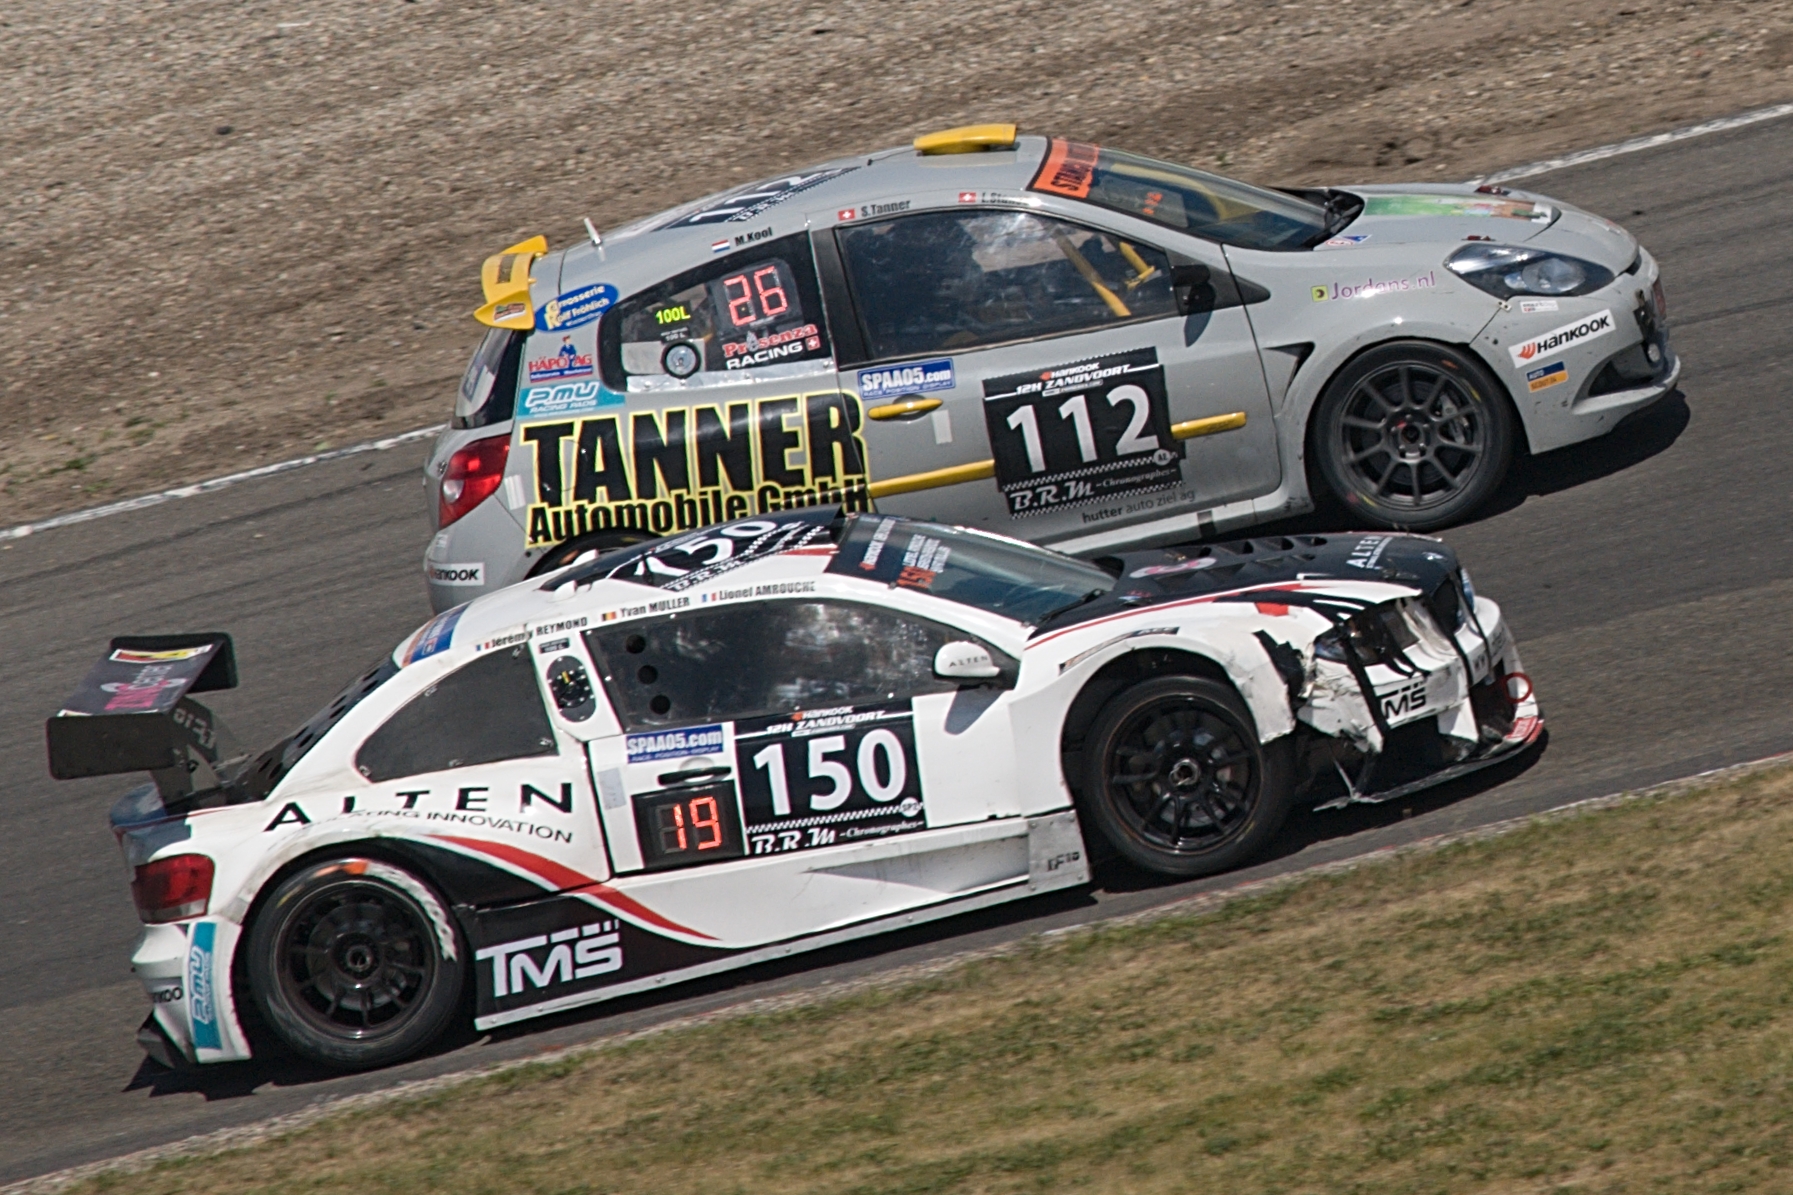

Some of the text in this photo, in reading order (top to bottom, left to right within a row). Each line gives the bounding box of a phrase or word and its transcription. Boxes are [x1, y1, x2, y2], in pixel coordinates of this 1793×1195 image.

[861, 199, 911, 217] S.Tanner
[735, 227, 773, 247] M.Kool
[724, 265, 788, 327] 26
[1332, 271, 1436, 300] Jordans.nl
[655, 306, 691, 324] 100L
[574, 353, 592, 367] AG
[726, 341, 803, 370] RACING
[861, 366, 951, 392] SPAA05.com
[1016, 381, 1043, 396] 12H
[1044, 364, 1131, 389] ZANDVOORT
[1006, 384, 1160, 473] 112
[522, 391, 868, 506] TANNER
[1010, 480, 1095, 510] B.R.M
[1082, 489, 1196, 524] hutter auto ziel ag
[528, 489, 748, 546] Automobile
[756, 477, 869, 516] GmbH
[633, 520, 778, 575] 150
[719, 581, 816, 600] Lionel AMROUCHE
[536, 617, 588, 636] REYMOND
[620, 606, 647, 618] Yvan
[766, 723, 794, 735] 12H
[796, 710, 886, 731] ZANDVOORT
[627, 731, 723, 755] SPAA05.com
[753, 728, 907, 816] 150
[426, 811, 573, 844] INNOVATION
[673, 796, 722, 850] 19
[475, 928, 624, 998] TMS
